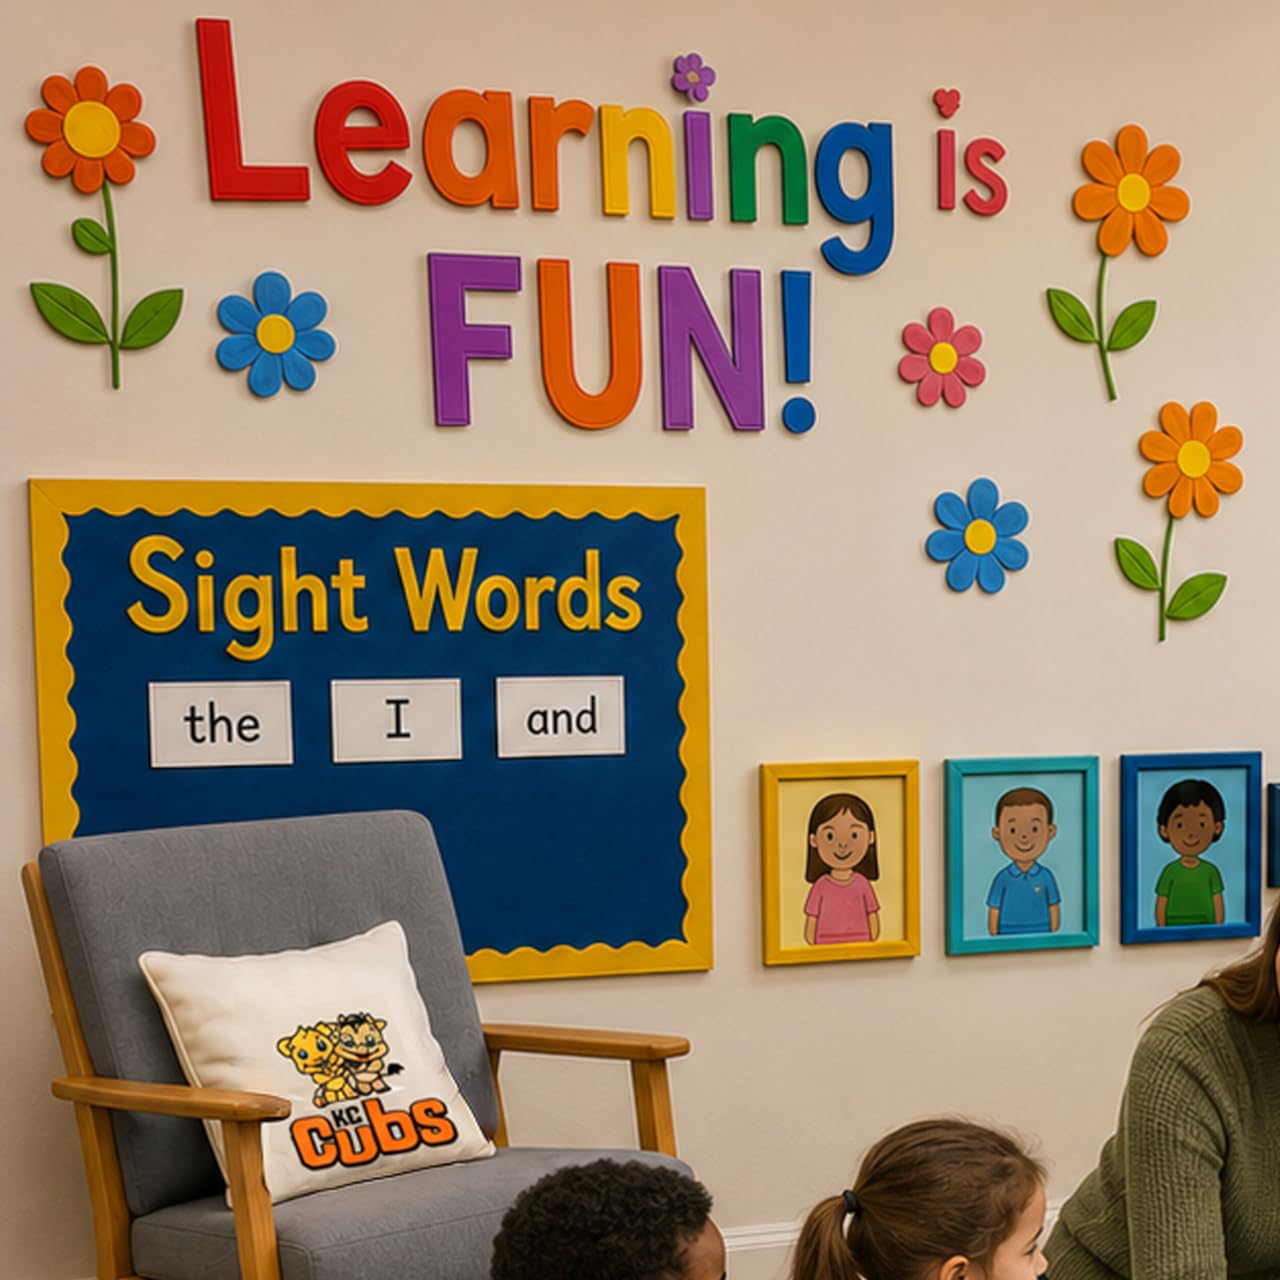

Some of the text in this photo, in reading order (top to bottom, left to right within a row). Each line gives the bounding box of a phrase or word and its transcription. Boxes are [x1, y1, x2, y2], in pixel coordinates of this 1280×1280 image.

[196, 17, 1008, 276] Learning is
[427, 253, 815, 433] FUN!
[128, 535, 641, 660] Sight Words
[184, 701, 259, 743] the
[386, 699, 410, 738] I
[528, 696, 596, 734] and
[289, 1097, 459, 1170] Cubs
[331, 1104, 364, 1127] KC
